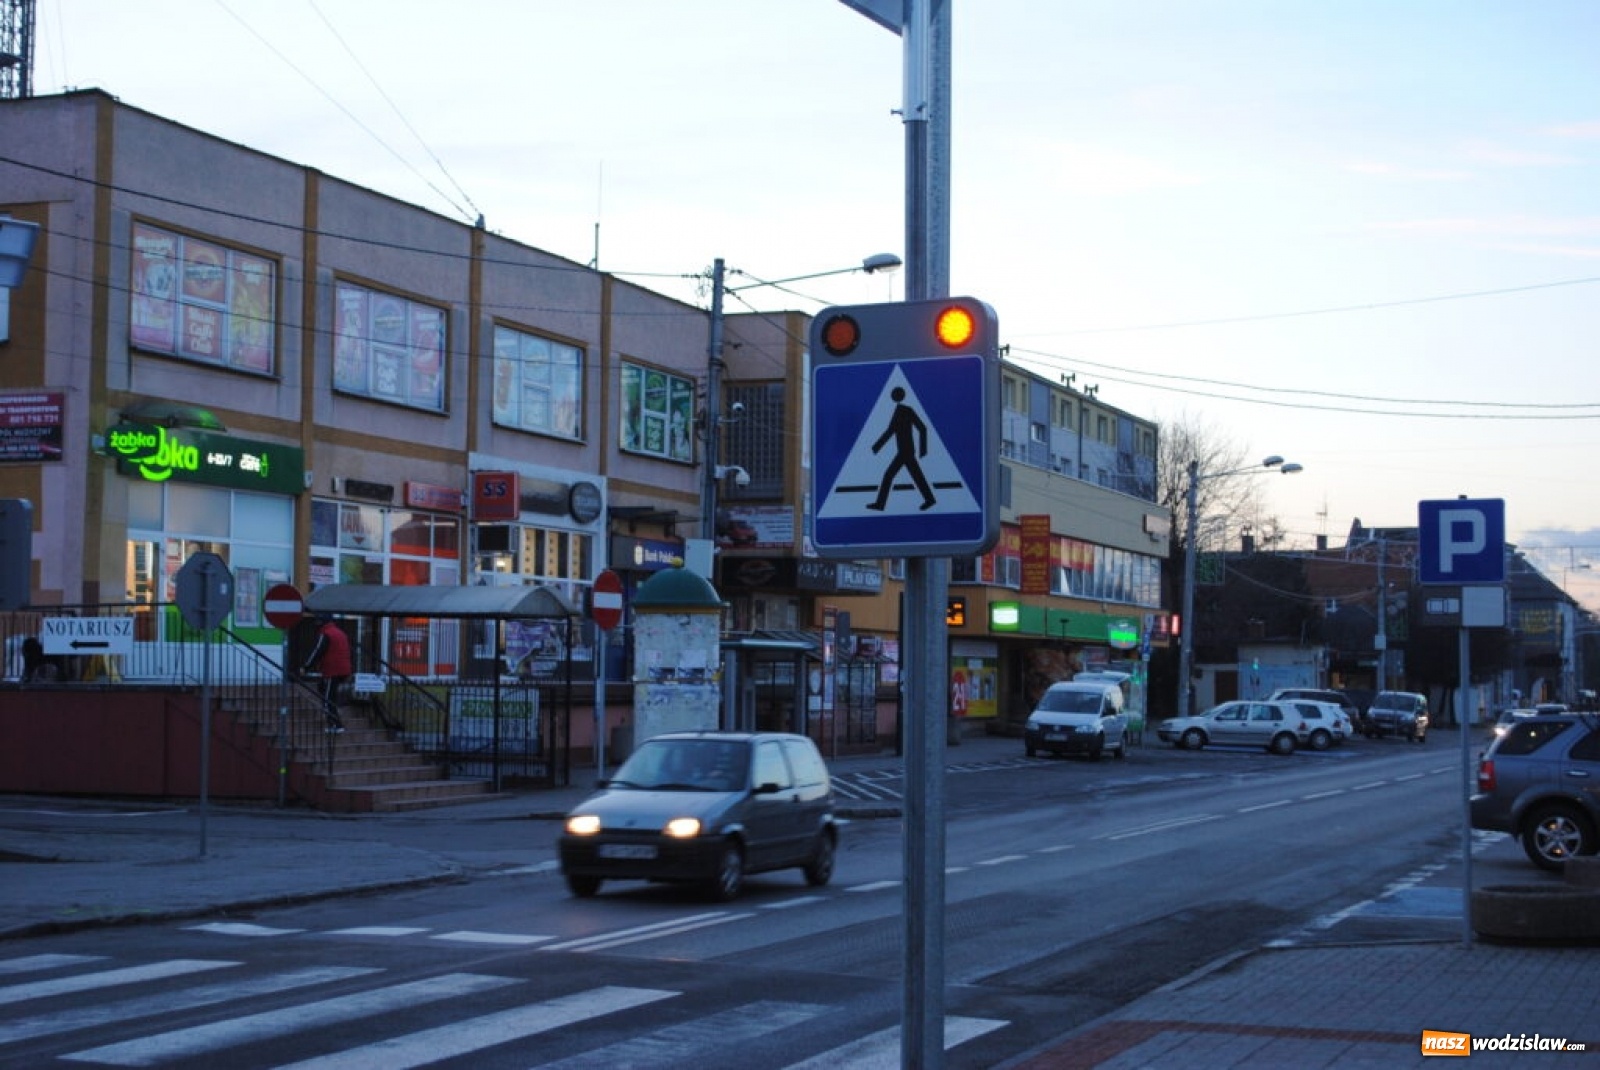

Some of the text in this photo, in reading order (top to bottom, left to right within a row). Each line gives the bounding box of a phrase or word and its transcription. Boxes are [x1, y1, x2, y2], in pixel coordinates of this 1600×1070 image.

[111, 431, 156, 448] żabka
[1439, 509, 1486, 573] P
[46, 621, 132, 637] NOTARIUSZ
